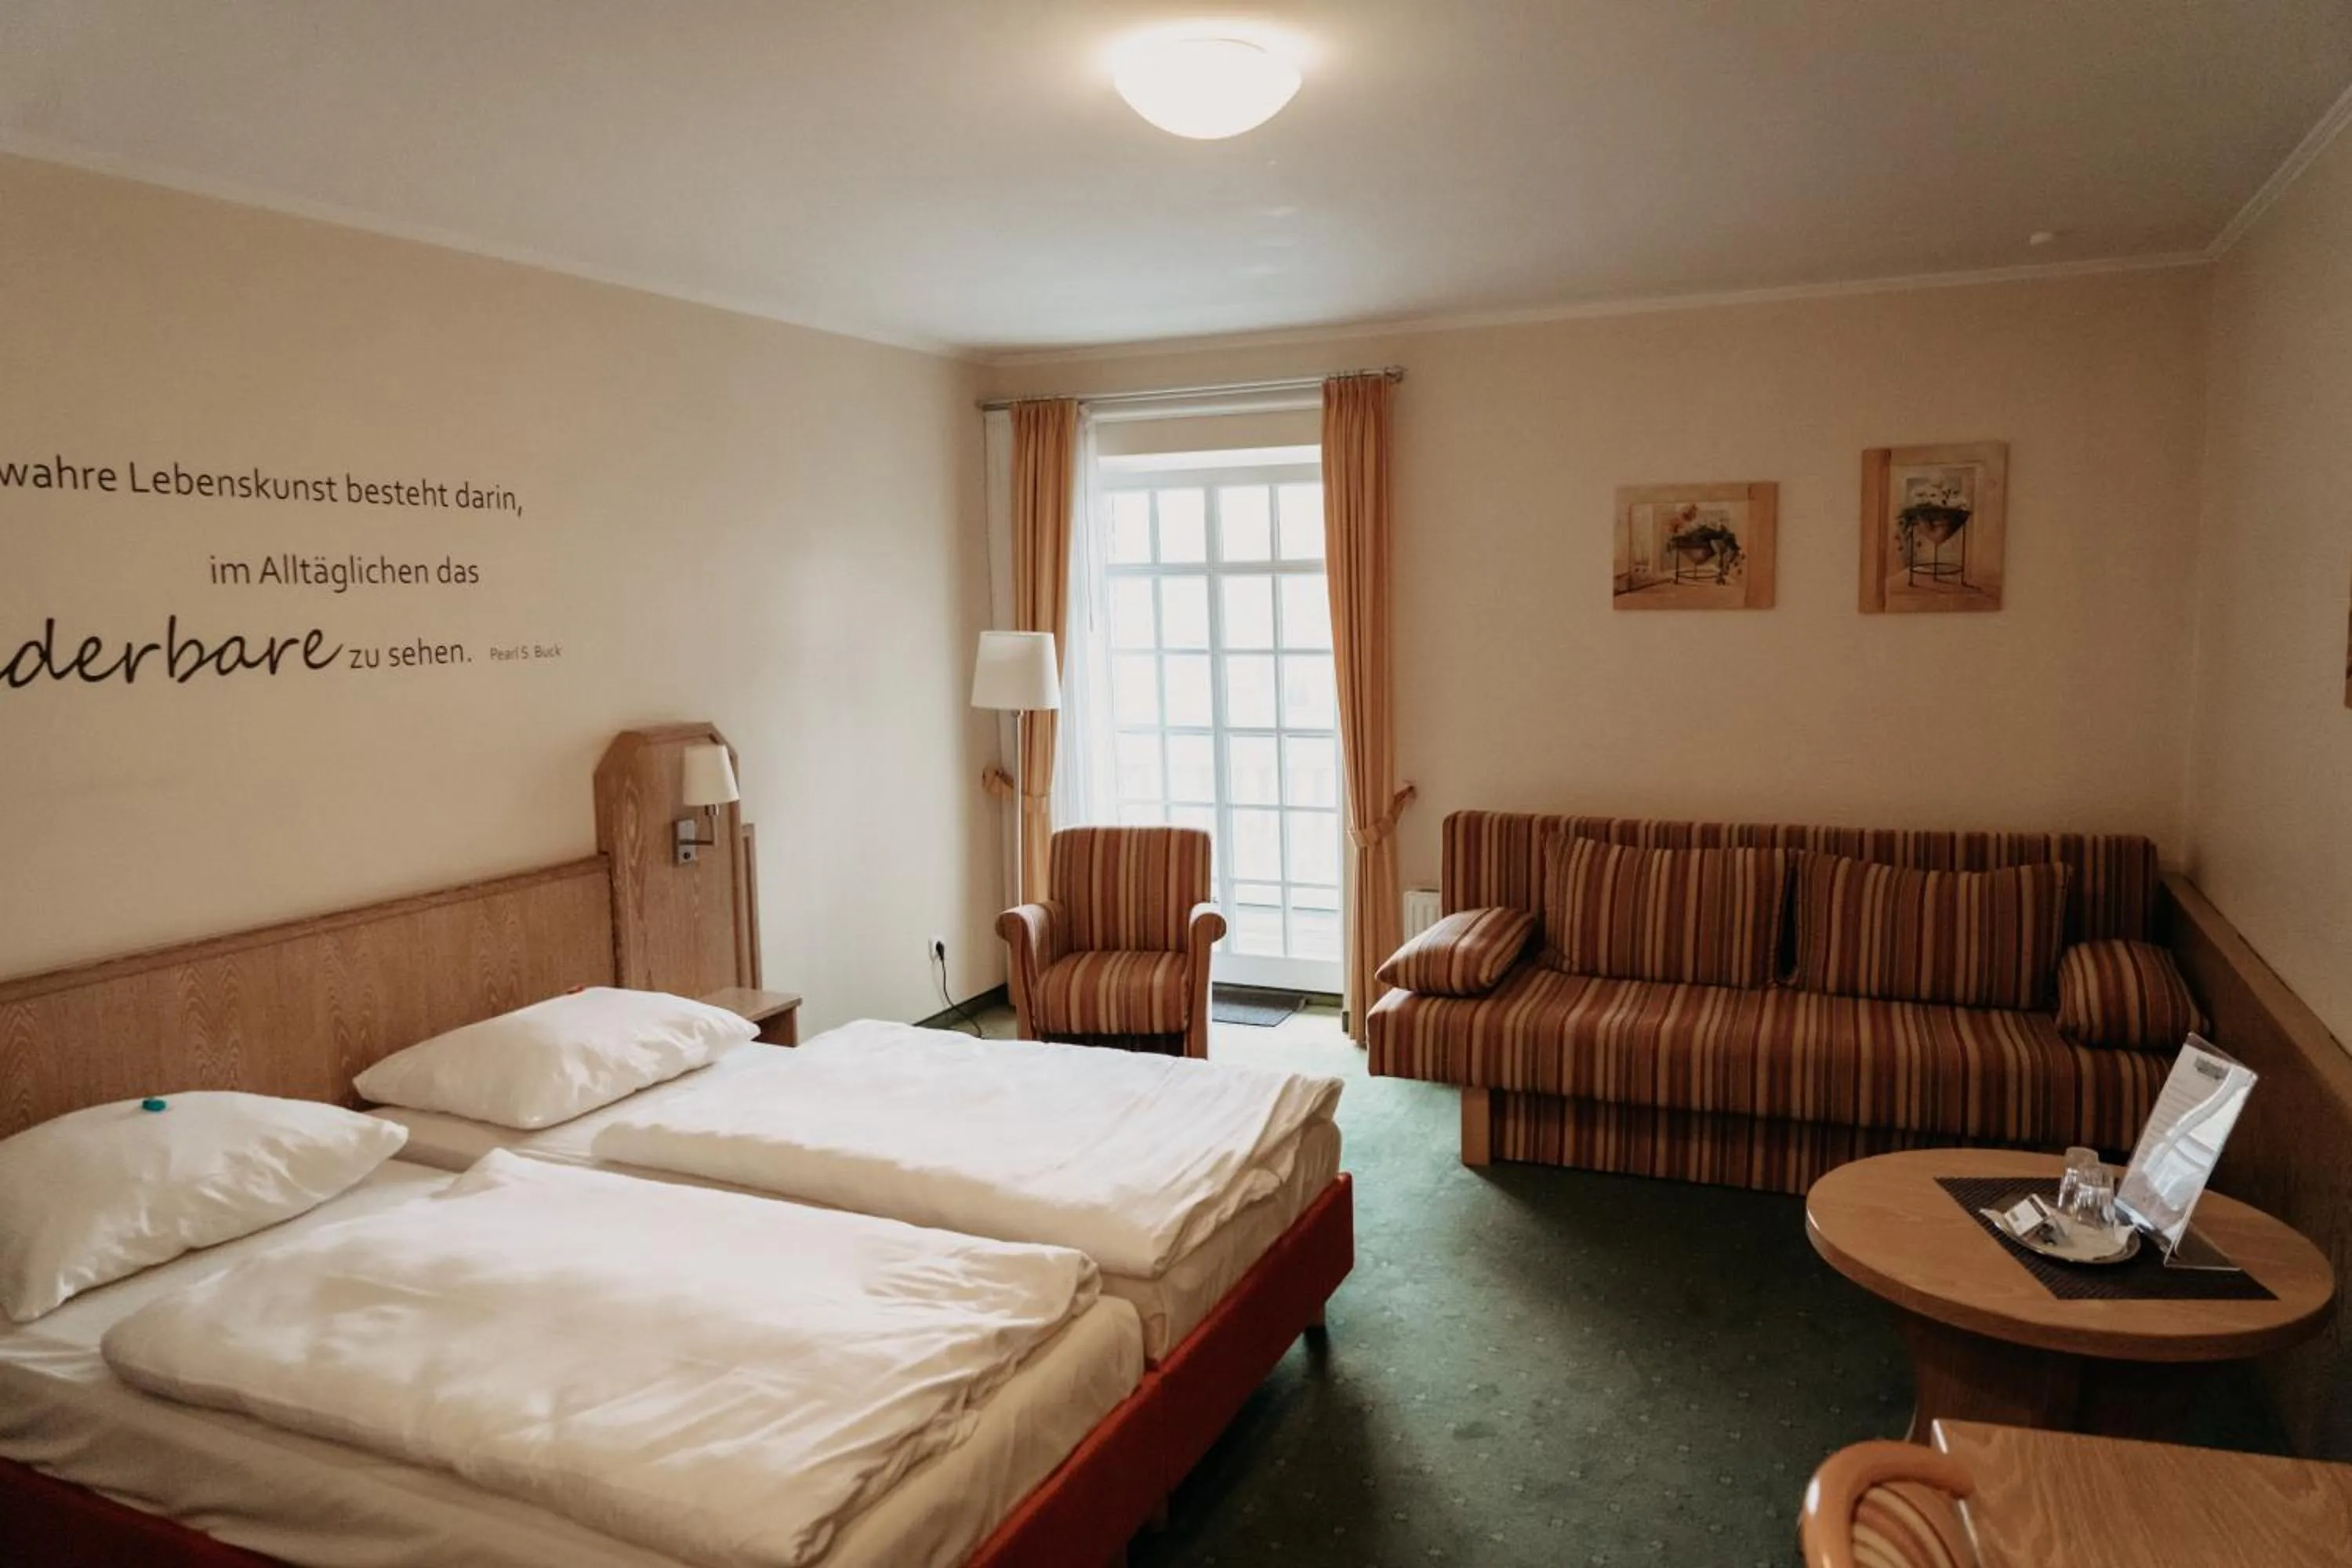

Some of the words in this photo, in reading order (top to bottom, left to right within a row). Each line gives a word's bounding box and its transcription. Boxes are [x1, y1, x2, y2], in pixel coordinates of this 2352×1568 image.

[0, 453, 118, 492] wahre
[129, 461, 339, 503] Lebenskunst
[345, 472, 448, 507] besteht
[456, 481, 522, 519] darin,
[209, 555, 251, 585] im
[258, 554, 429, 594] Alltäglichen
[437, 555, 479, 585] das
[0, 615, 344, 689] derbare
[348, 648, 380, 670] zu
[388, 637, 472, 667] sehen.
[490, 645, 519, 661] Pearl
[534, 643, 563, 659] Buck
